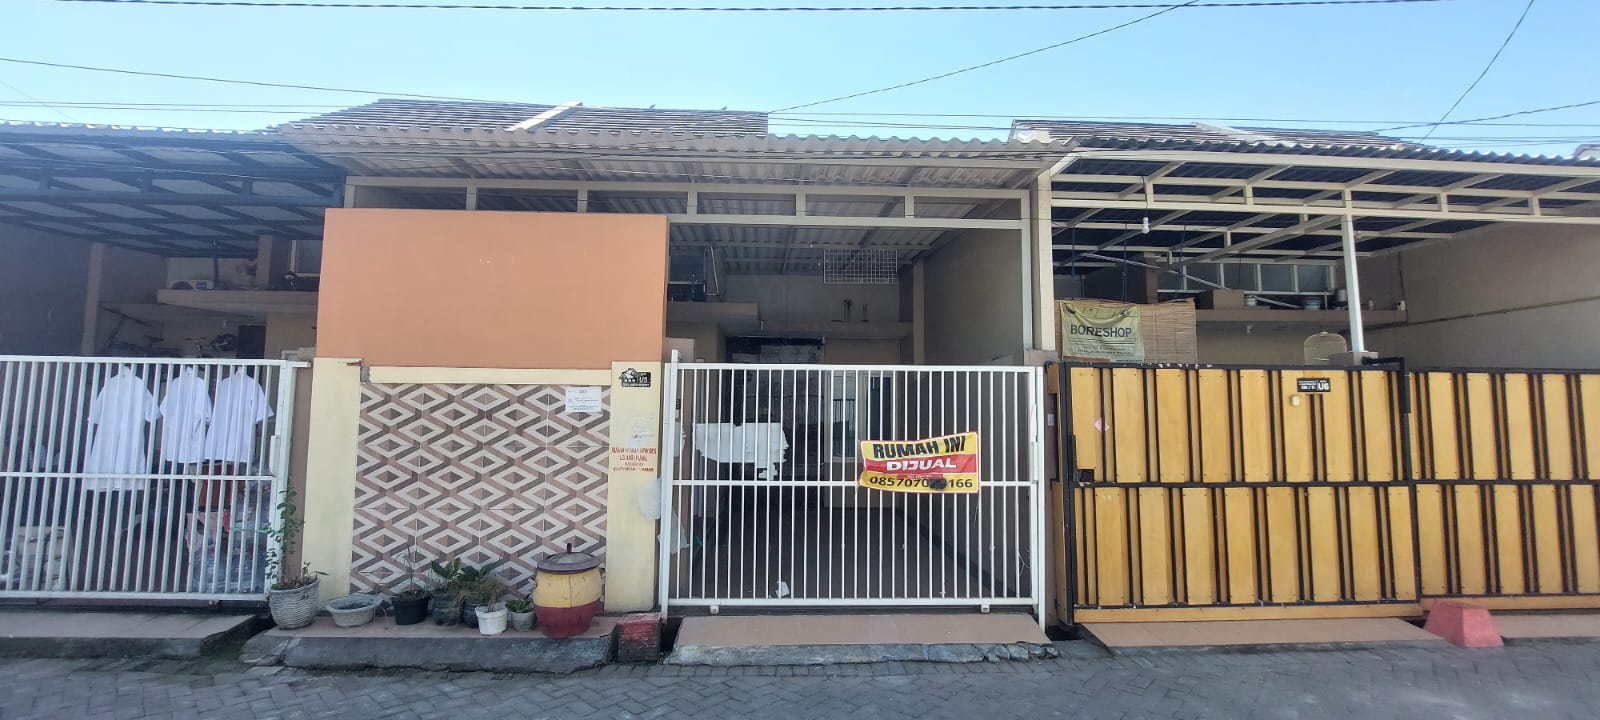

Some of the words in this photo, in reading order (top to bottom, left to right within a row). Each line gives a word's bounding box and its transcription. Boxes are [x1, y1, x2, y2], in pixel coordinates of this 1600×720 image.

[1071, 325, 1132, 338] BORESHOP
[1318, 382, 1330, 390] U6
[872, 440, 939, 459] RUMAH
[943, 435, 966, 453] INI
[886, 458, 957, 471] DIJUAL
[869, 476, 973, 489] 0857070166
